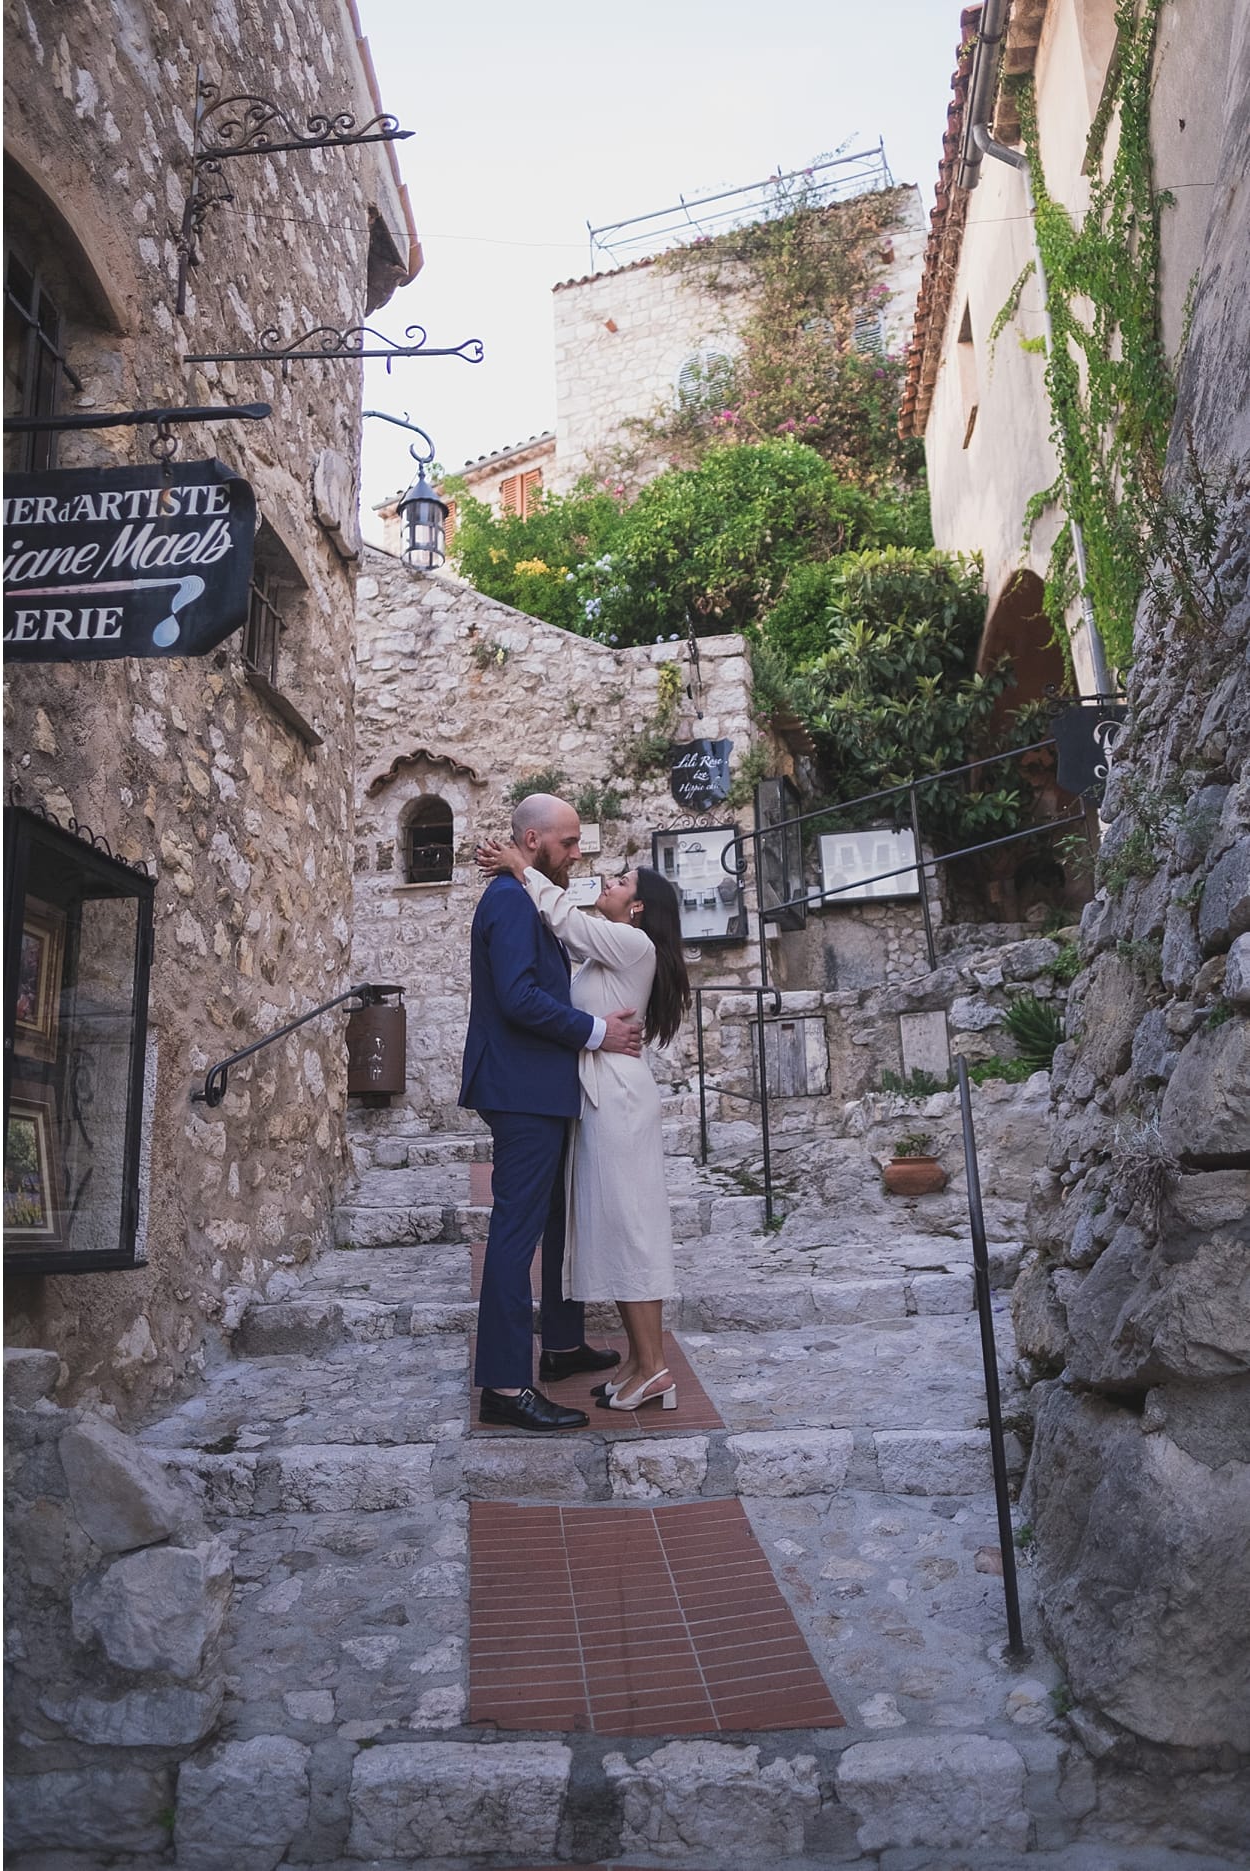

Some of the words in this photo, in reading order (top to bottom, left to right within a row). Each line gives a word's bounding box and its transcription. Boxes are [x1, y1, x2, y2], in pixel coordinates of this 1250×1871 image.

[94, 519, 233, 578] Maels
[3, 607, 123, 641] ERIE
[672, 753, 698, 769] Lili
